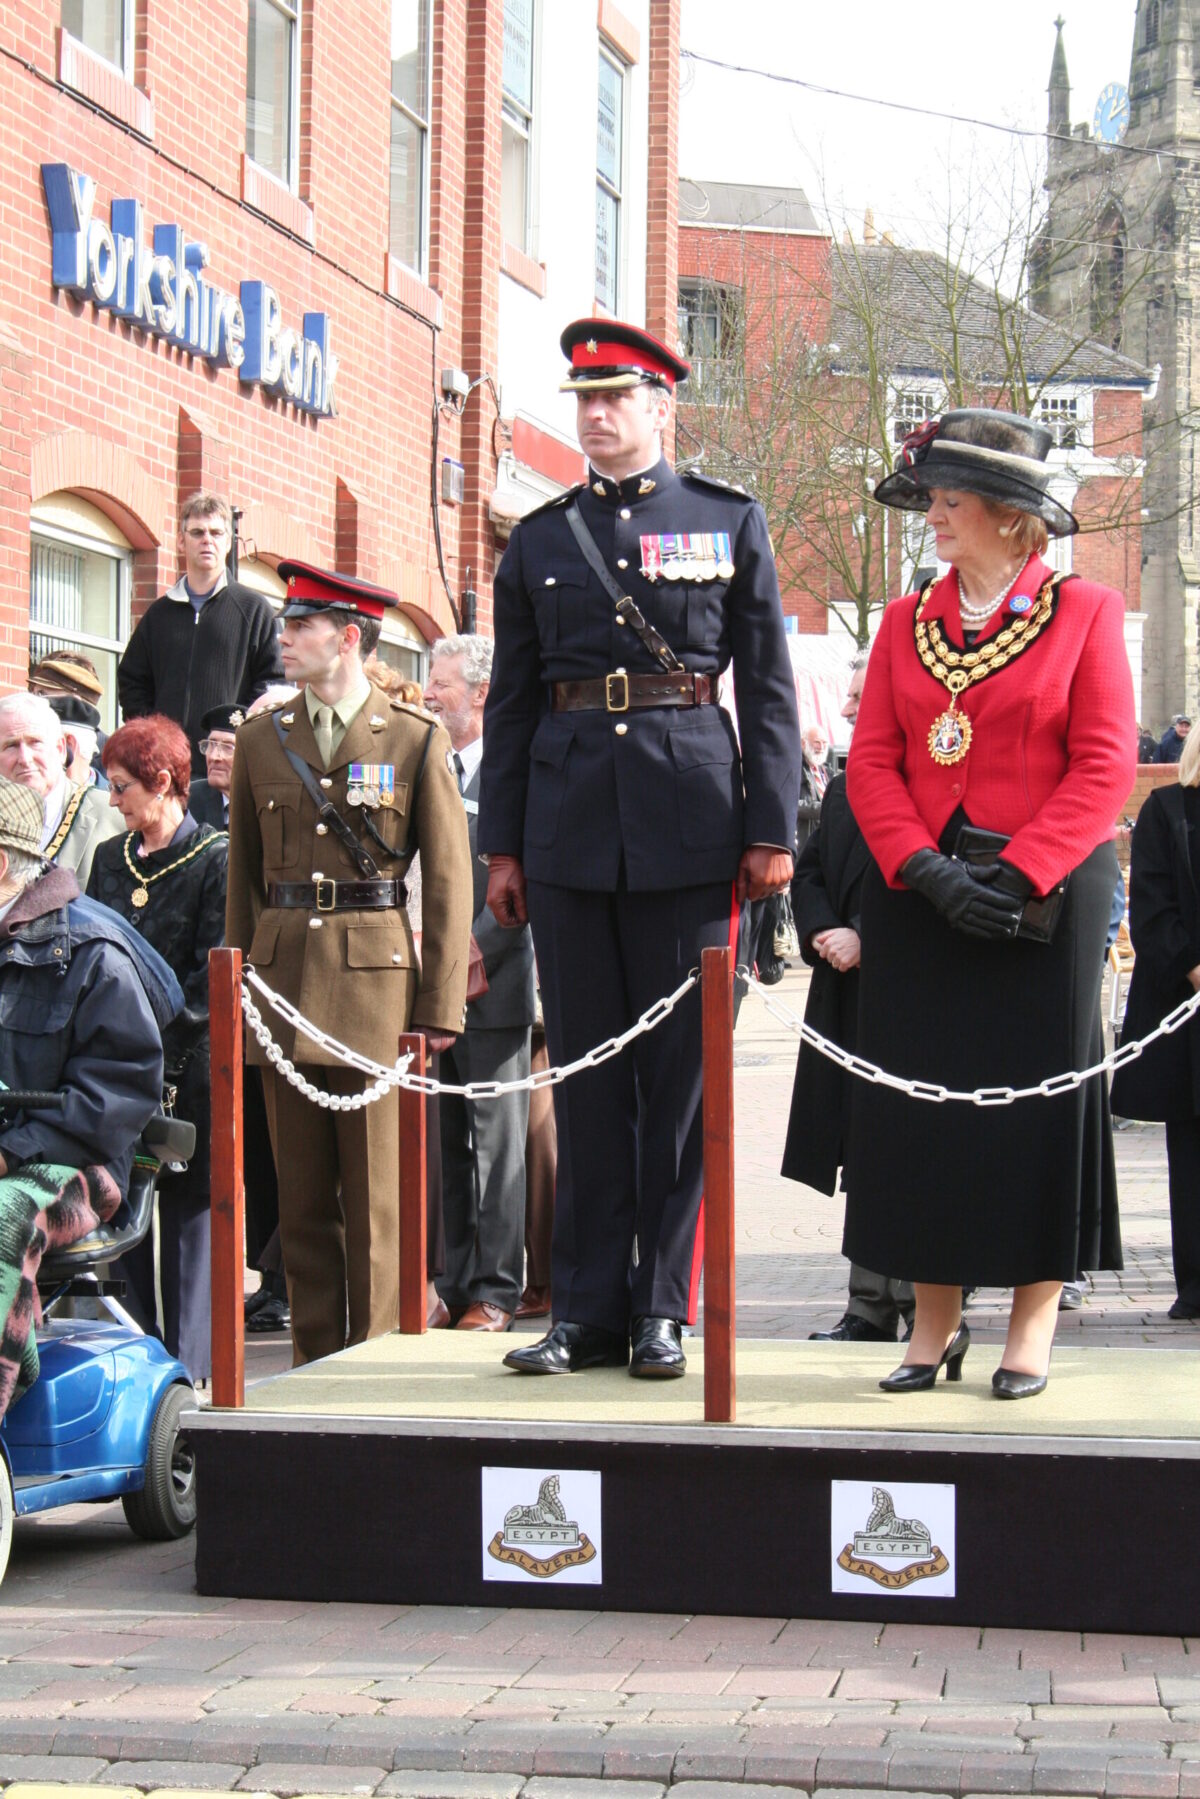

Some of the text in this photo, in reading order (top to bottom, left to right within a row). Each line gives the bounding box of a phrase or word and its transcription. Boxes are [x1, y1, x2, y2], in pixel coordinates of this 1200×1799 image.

[41, 163, 340, 419] Yorkshire Bank
[513, 1530, 570, 1540] EGYPT
[863, 1542, 922, 1552] EGYPT
[498, 1549, 587, 1573] TALAVERA
[847, 1558, 938, 1584] TALAVERA
